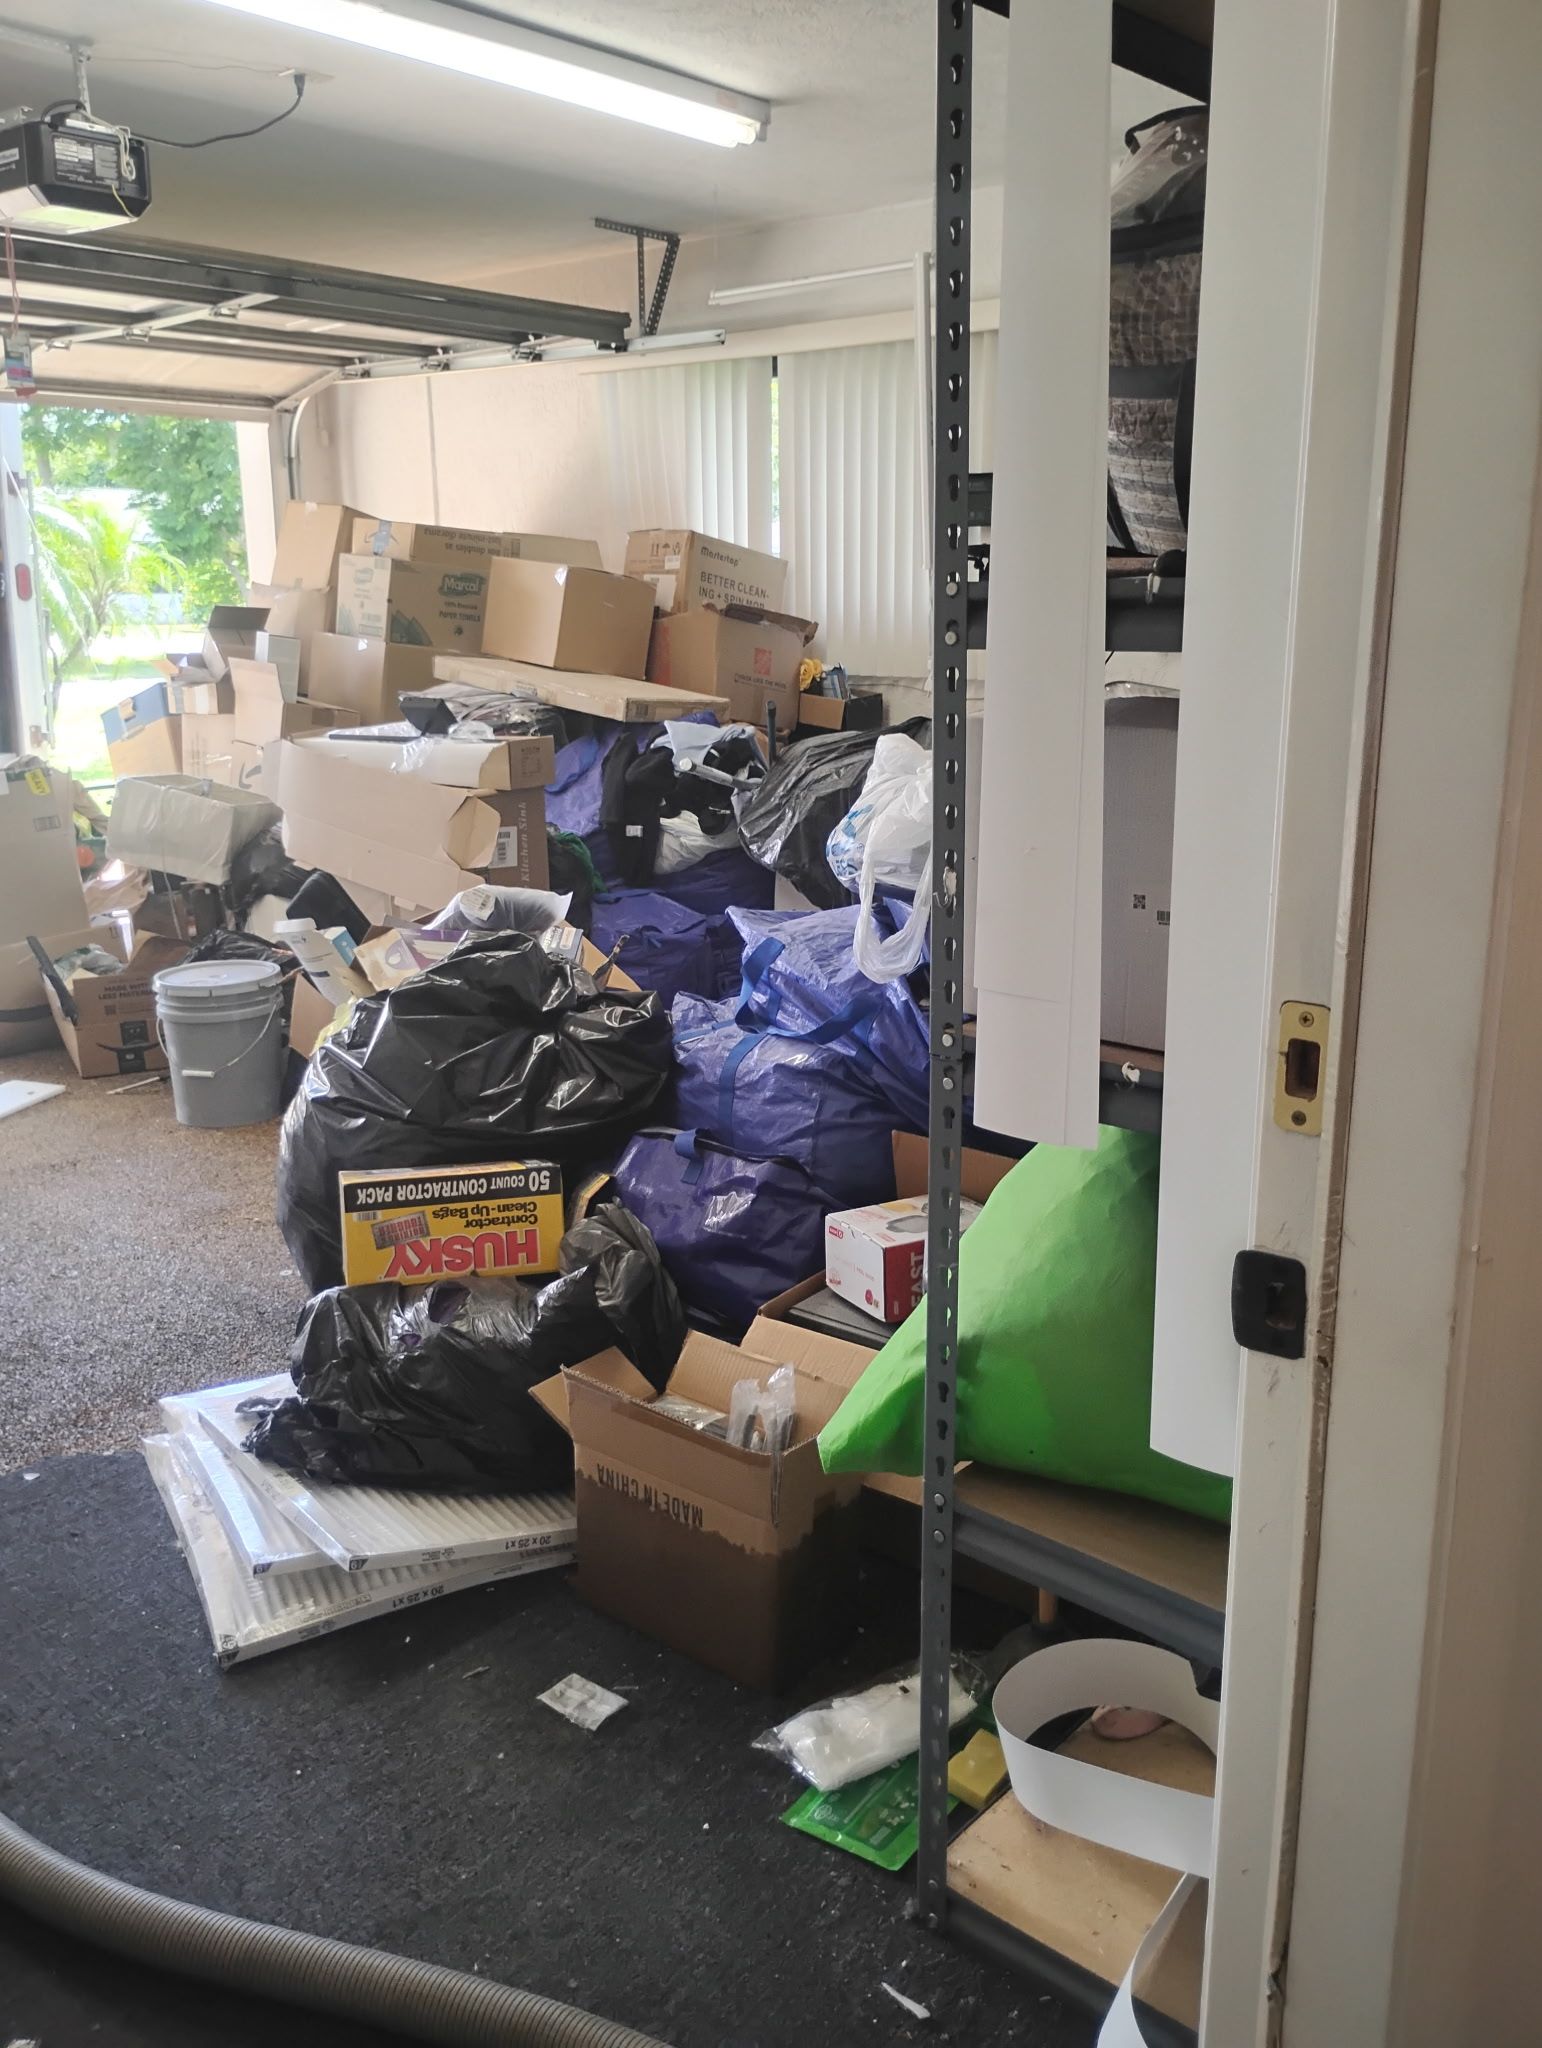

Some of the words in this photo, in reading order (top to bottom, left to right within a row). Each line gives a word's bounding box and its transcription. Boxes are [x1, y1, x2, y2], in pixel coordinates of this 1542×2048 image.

[444, 577, 480, 592] Marcal
[699, 586, 714, 600] ING
[700, 571, 736, 592] BETTER
[737, 582, 770, 599] CLEAN-
[518, 801, 529, 831] Sink
[520, 833, 530, 882] Kitchen
[396, 1177, 488, 1201] CONTRACTOR
[490, 1174, 525, 1190] COUNT
[528, 1170, 551, 1192] 50
[356, 1186, 393, 1205] PACK
[432, 1206, 469, 1221] Bags
[463, 1213, 538, 1230] Contractor
[383, 1228, 541, 1280] HUSKY
[597, 1463, 639, 1497] CHINA
[644, 1483, 658, 1505] IN
[662, 1491, 703, 1529] MADE
[518, 1539, 530, 1549] 25
[539, 1535, 552, 1546] 20
[406, 1592, 420, 1604] 25
[431, 1584, 444, 1597] 20
